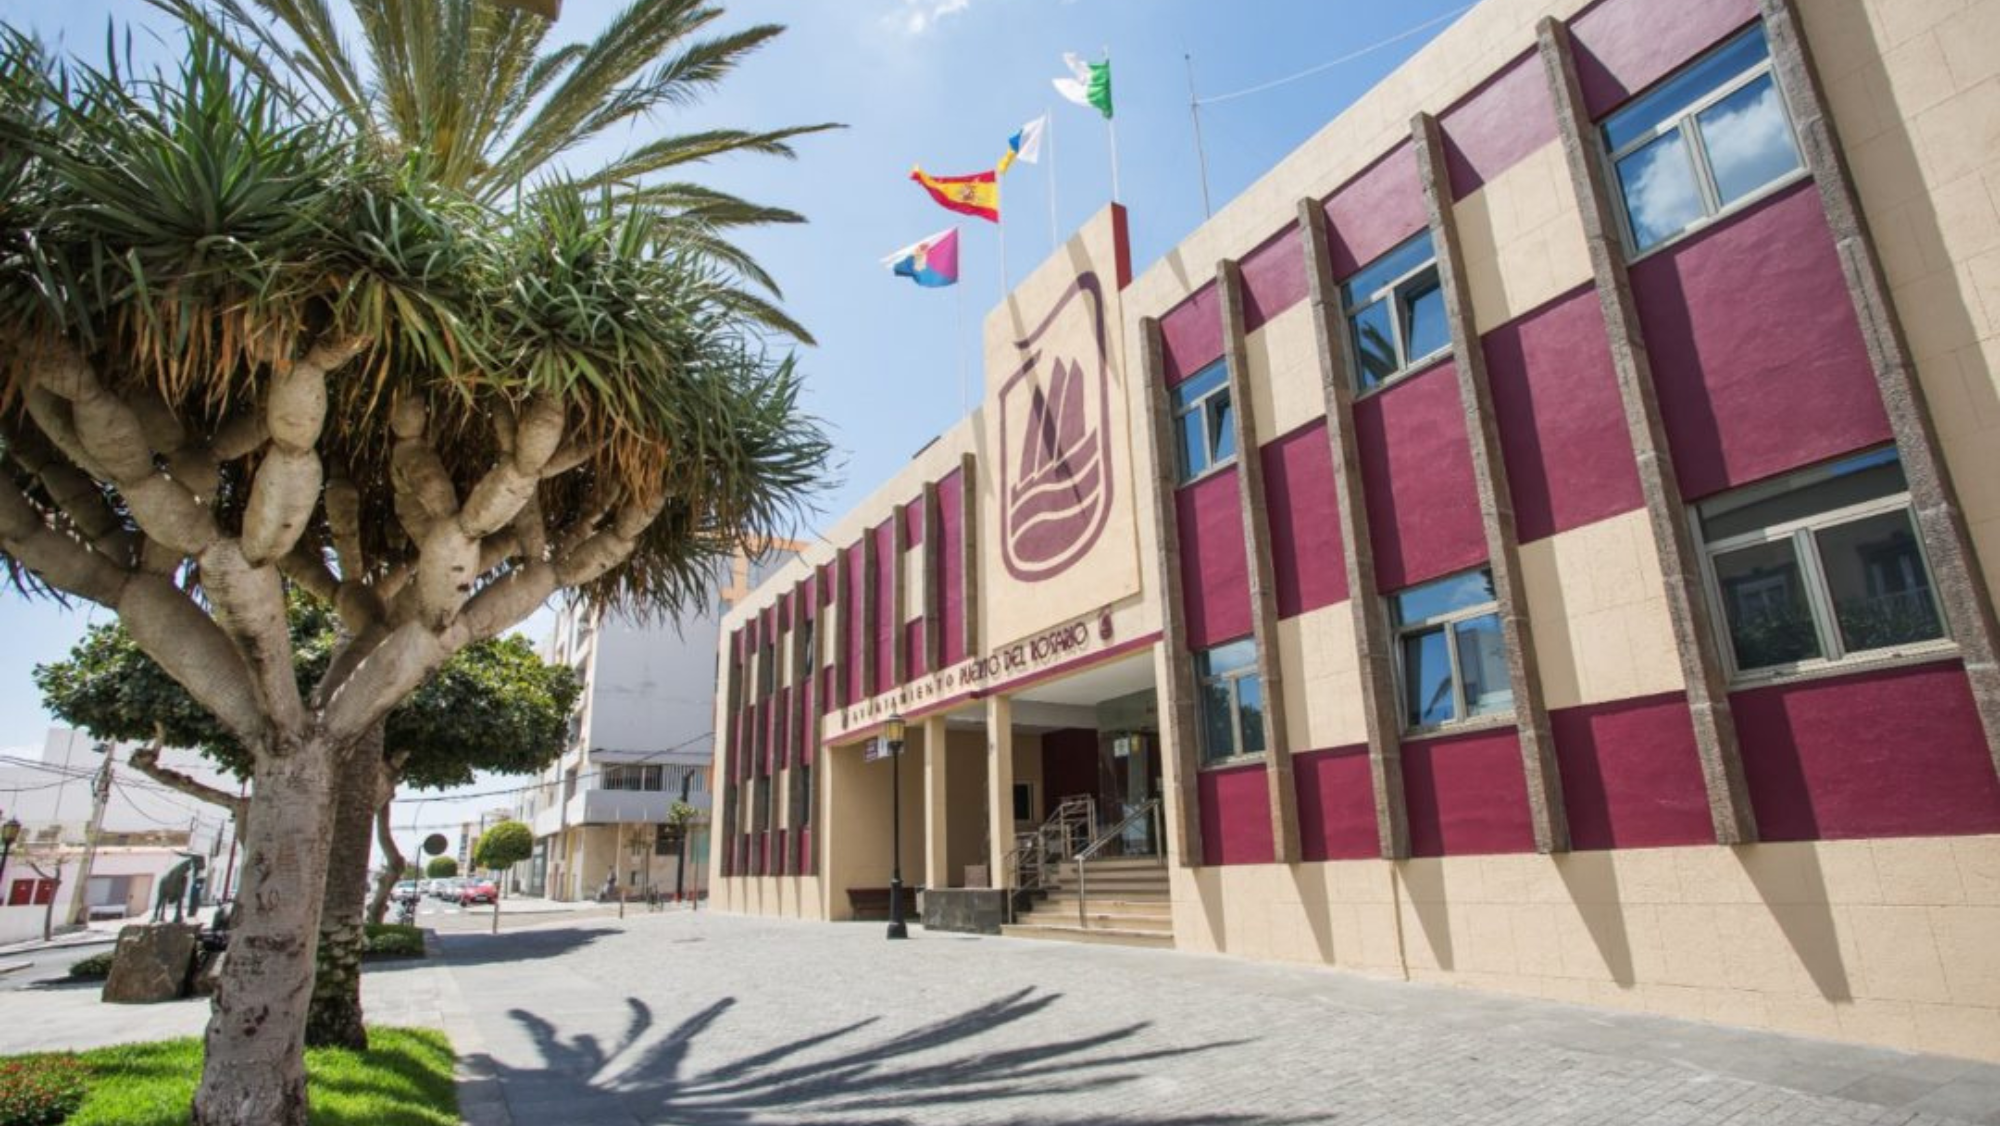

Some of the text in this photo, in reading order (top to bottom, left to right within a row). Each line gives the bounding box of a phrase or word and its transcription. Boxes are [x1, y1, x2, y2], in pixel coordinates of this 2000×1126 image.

[853, 674, 954, 723] AYUNTAMIENTO
[1004, 645, 1026, 670] DEL
[1031, 622, 1088, 660] ROSARIO
